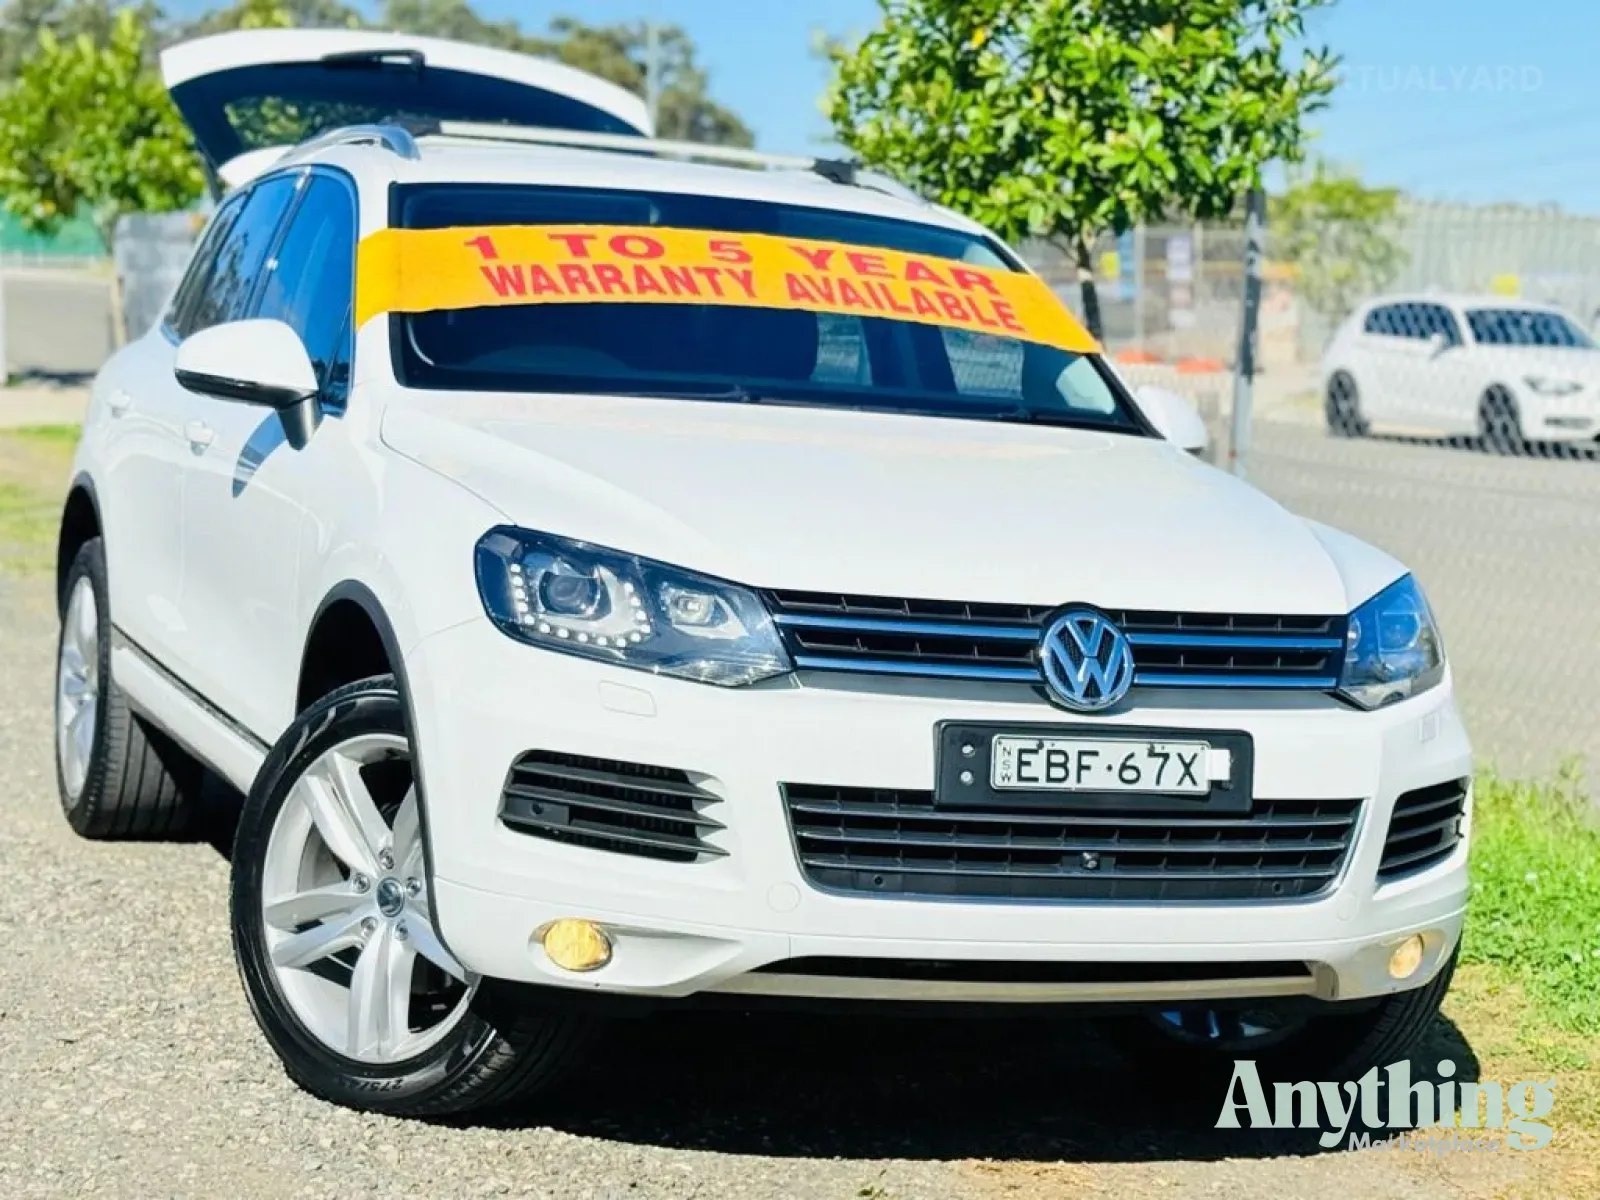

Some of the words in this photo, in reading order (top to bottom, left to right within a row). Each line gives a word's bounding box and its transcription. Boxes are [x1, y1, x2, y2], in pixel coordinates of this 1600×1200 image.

[464, 235, 498, 259] 1
[548, 233, 665, 260] TO
[709, 240, 753, 264] 5
[788, 246, 1002, 296] YEAR
[480, 263, 757, 298] WARRANTY
[785, 272, 1026, 332] AVAILABLE
[1000, 745, 1013, 783] NSW
